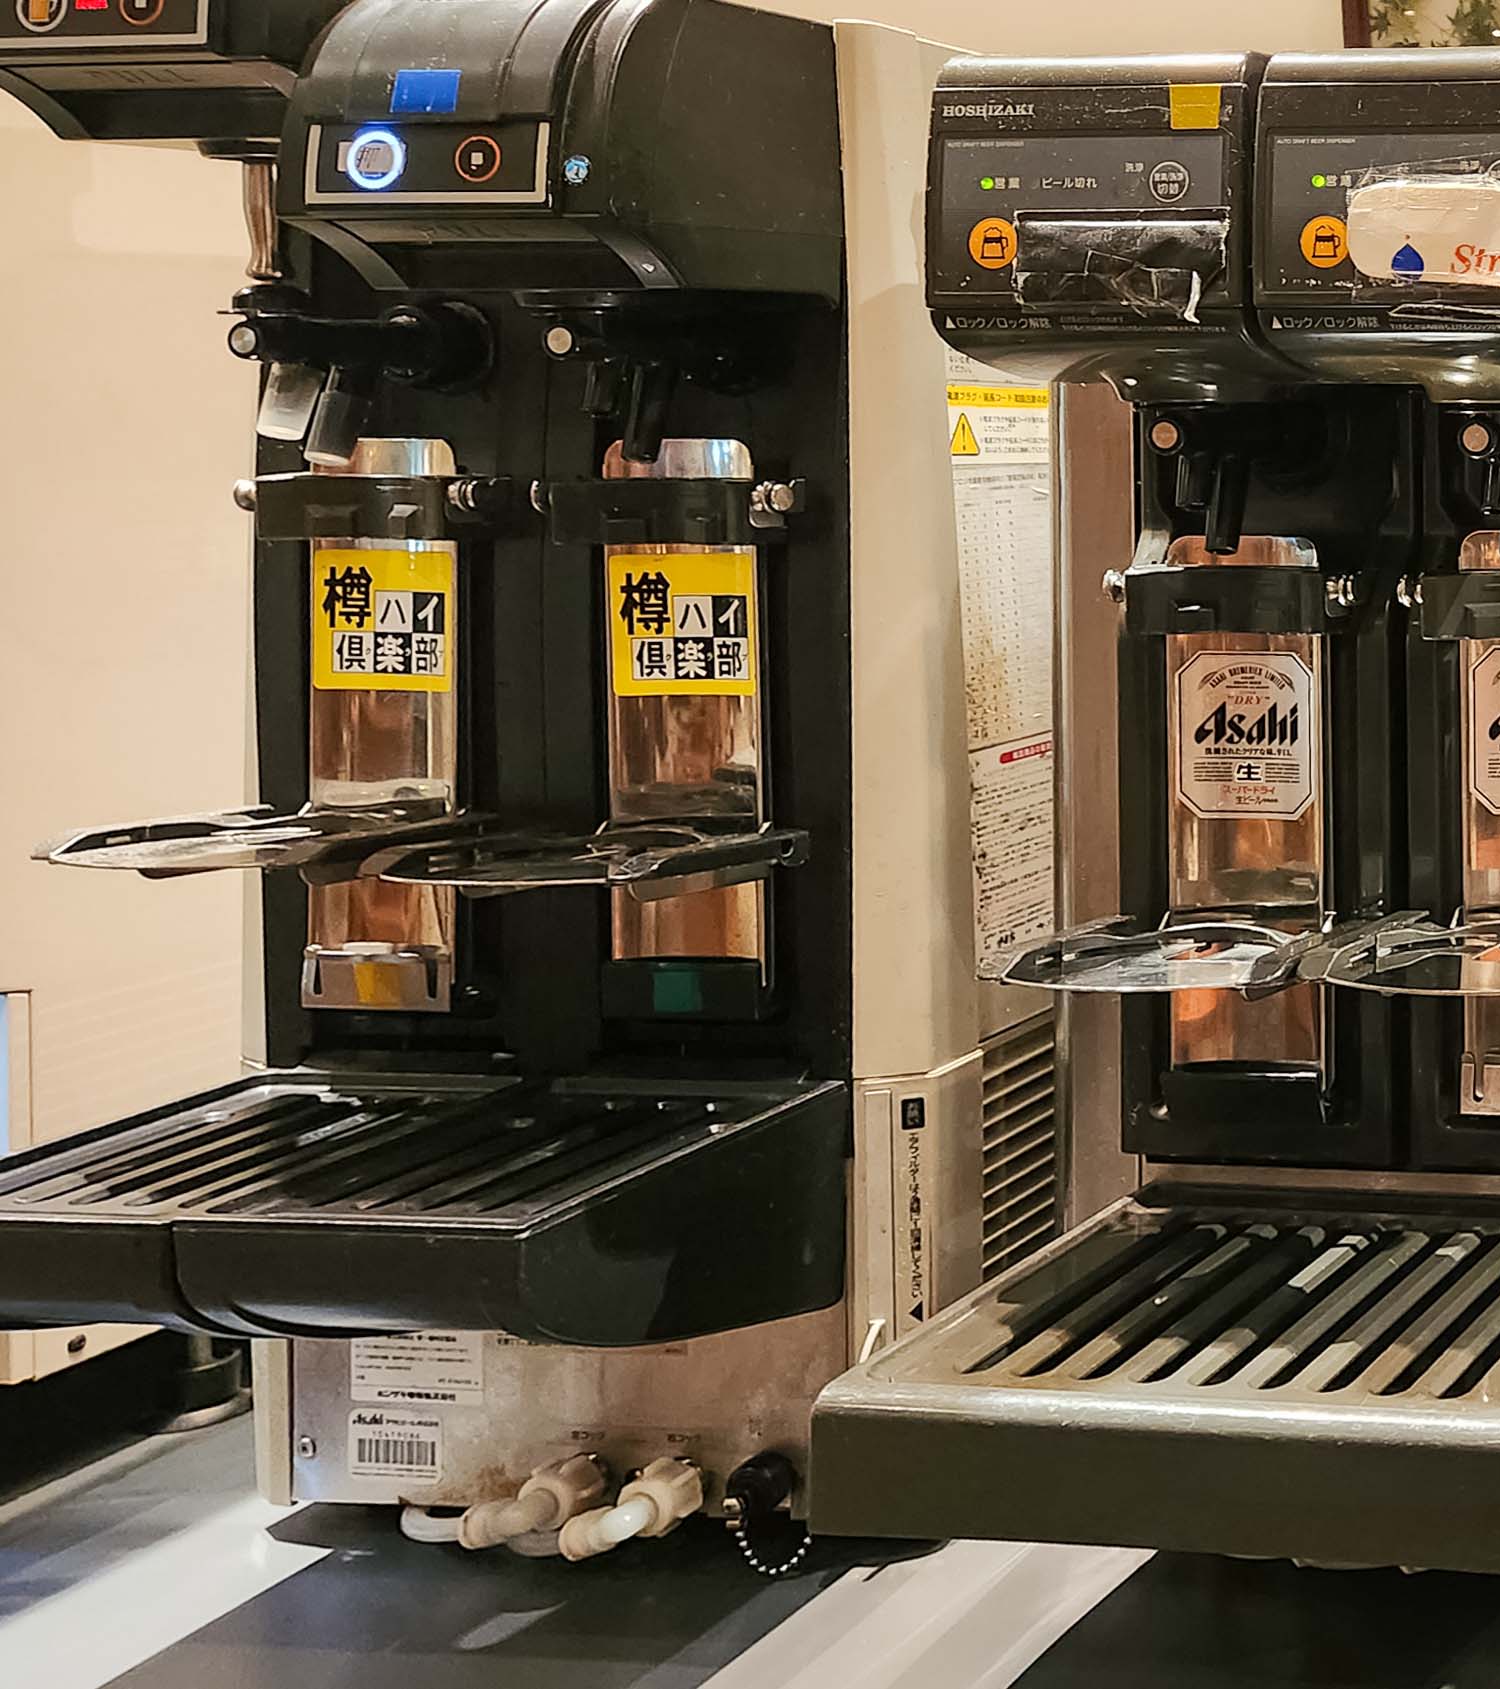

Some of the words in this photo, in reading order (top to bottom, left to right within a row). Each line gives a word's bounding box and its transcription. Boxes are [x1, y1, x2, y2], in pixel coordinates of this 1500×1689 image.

[942, 103, 1035, 119] HOSHIZAKI
[994, 177, 1021, 189] 営業
[1041, 176, 1098, 189] ビール切れ
[1193, 701, 1299, 746] Asahi
[1236, 763, 1262, 781] 生
